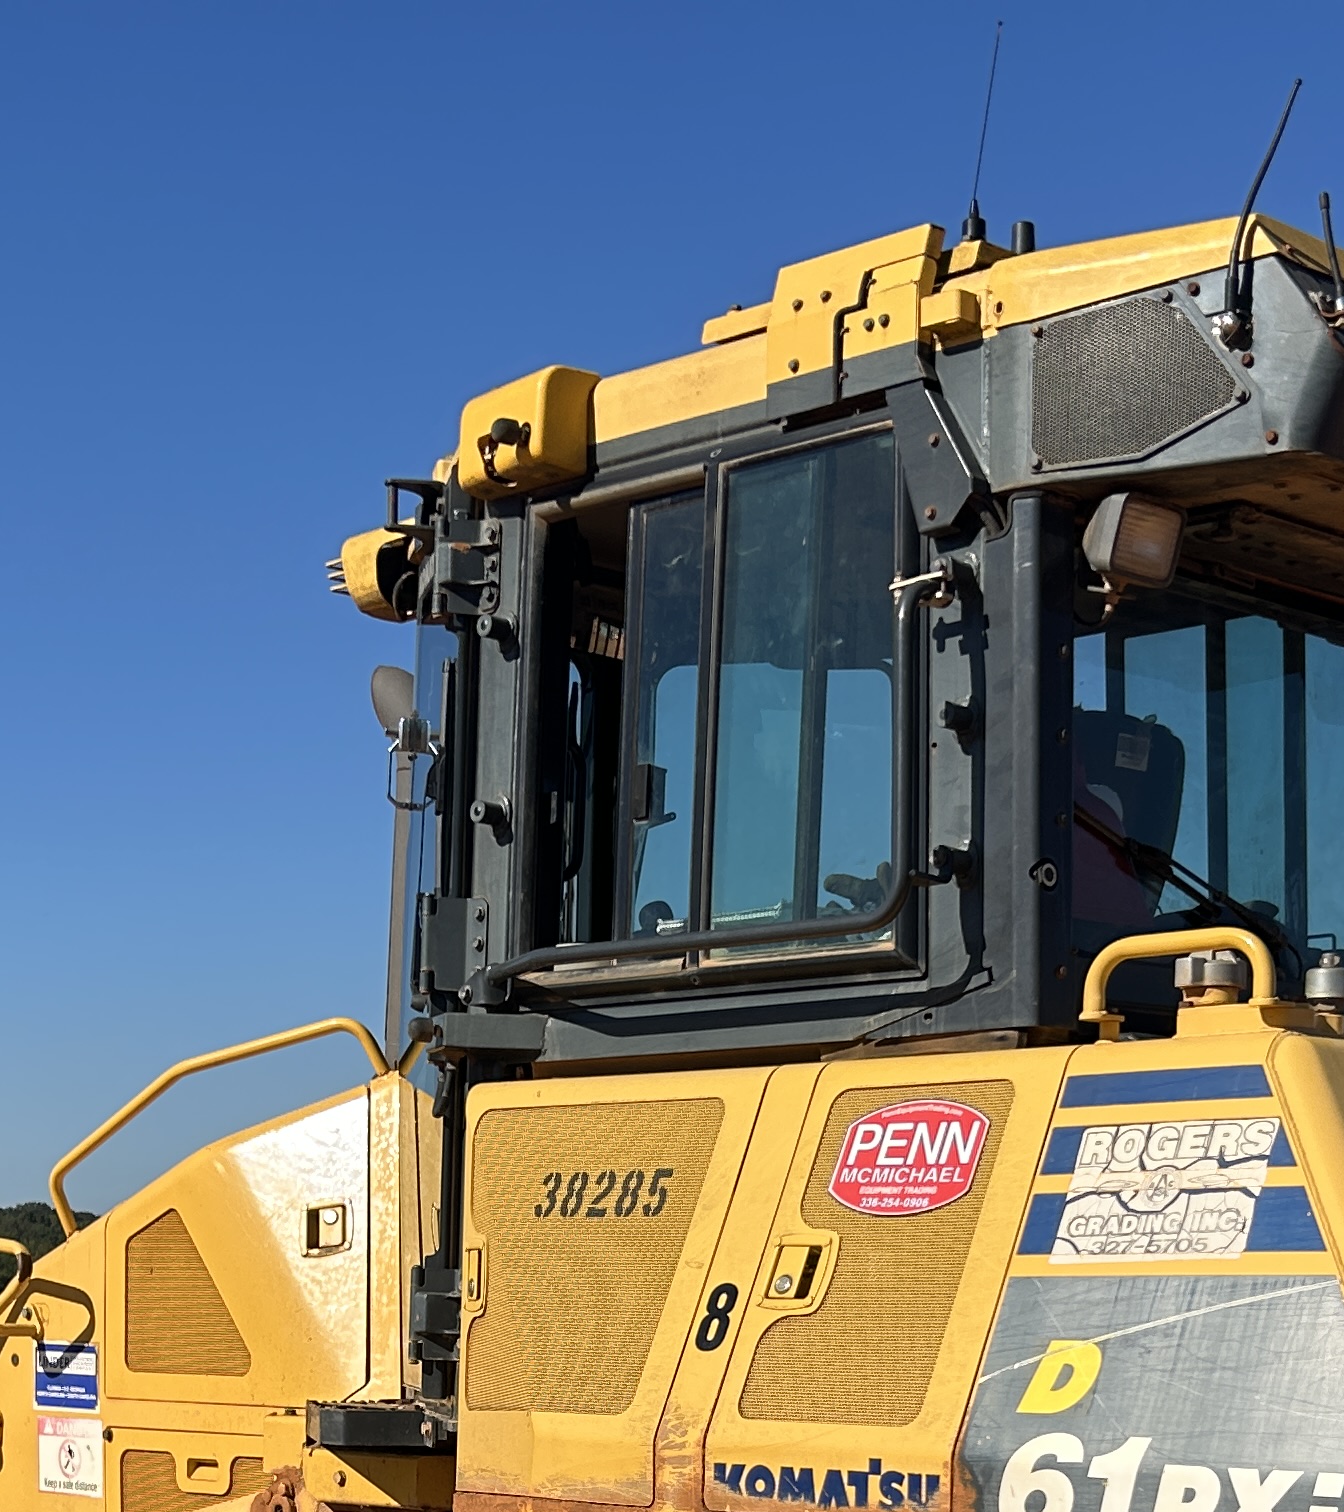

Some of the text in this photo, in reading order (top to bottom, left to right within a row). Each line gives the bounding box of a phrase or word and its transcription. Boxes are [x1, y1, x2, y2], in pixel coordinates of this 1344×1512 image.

[845, 1120, 981, 1166] PENN
[1078, 1120, 1276, 1166] ROGERS
[534, 1168, 674, 1217] 38285
[839, 1167, 965, 1184] MCMICHAEL
[1067, 1212, 1183, 1238] GRADING
[1090, 1237, 1208, 1254] 327-5705
[694, 1282, 739, 1351] 8
[1015, 1339, 1102, 1414] D
[713, 1458, 941, 1512] KOMATSU
